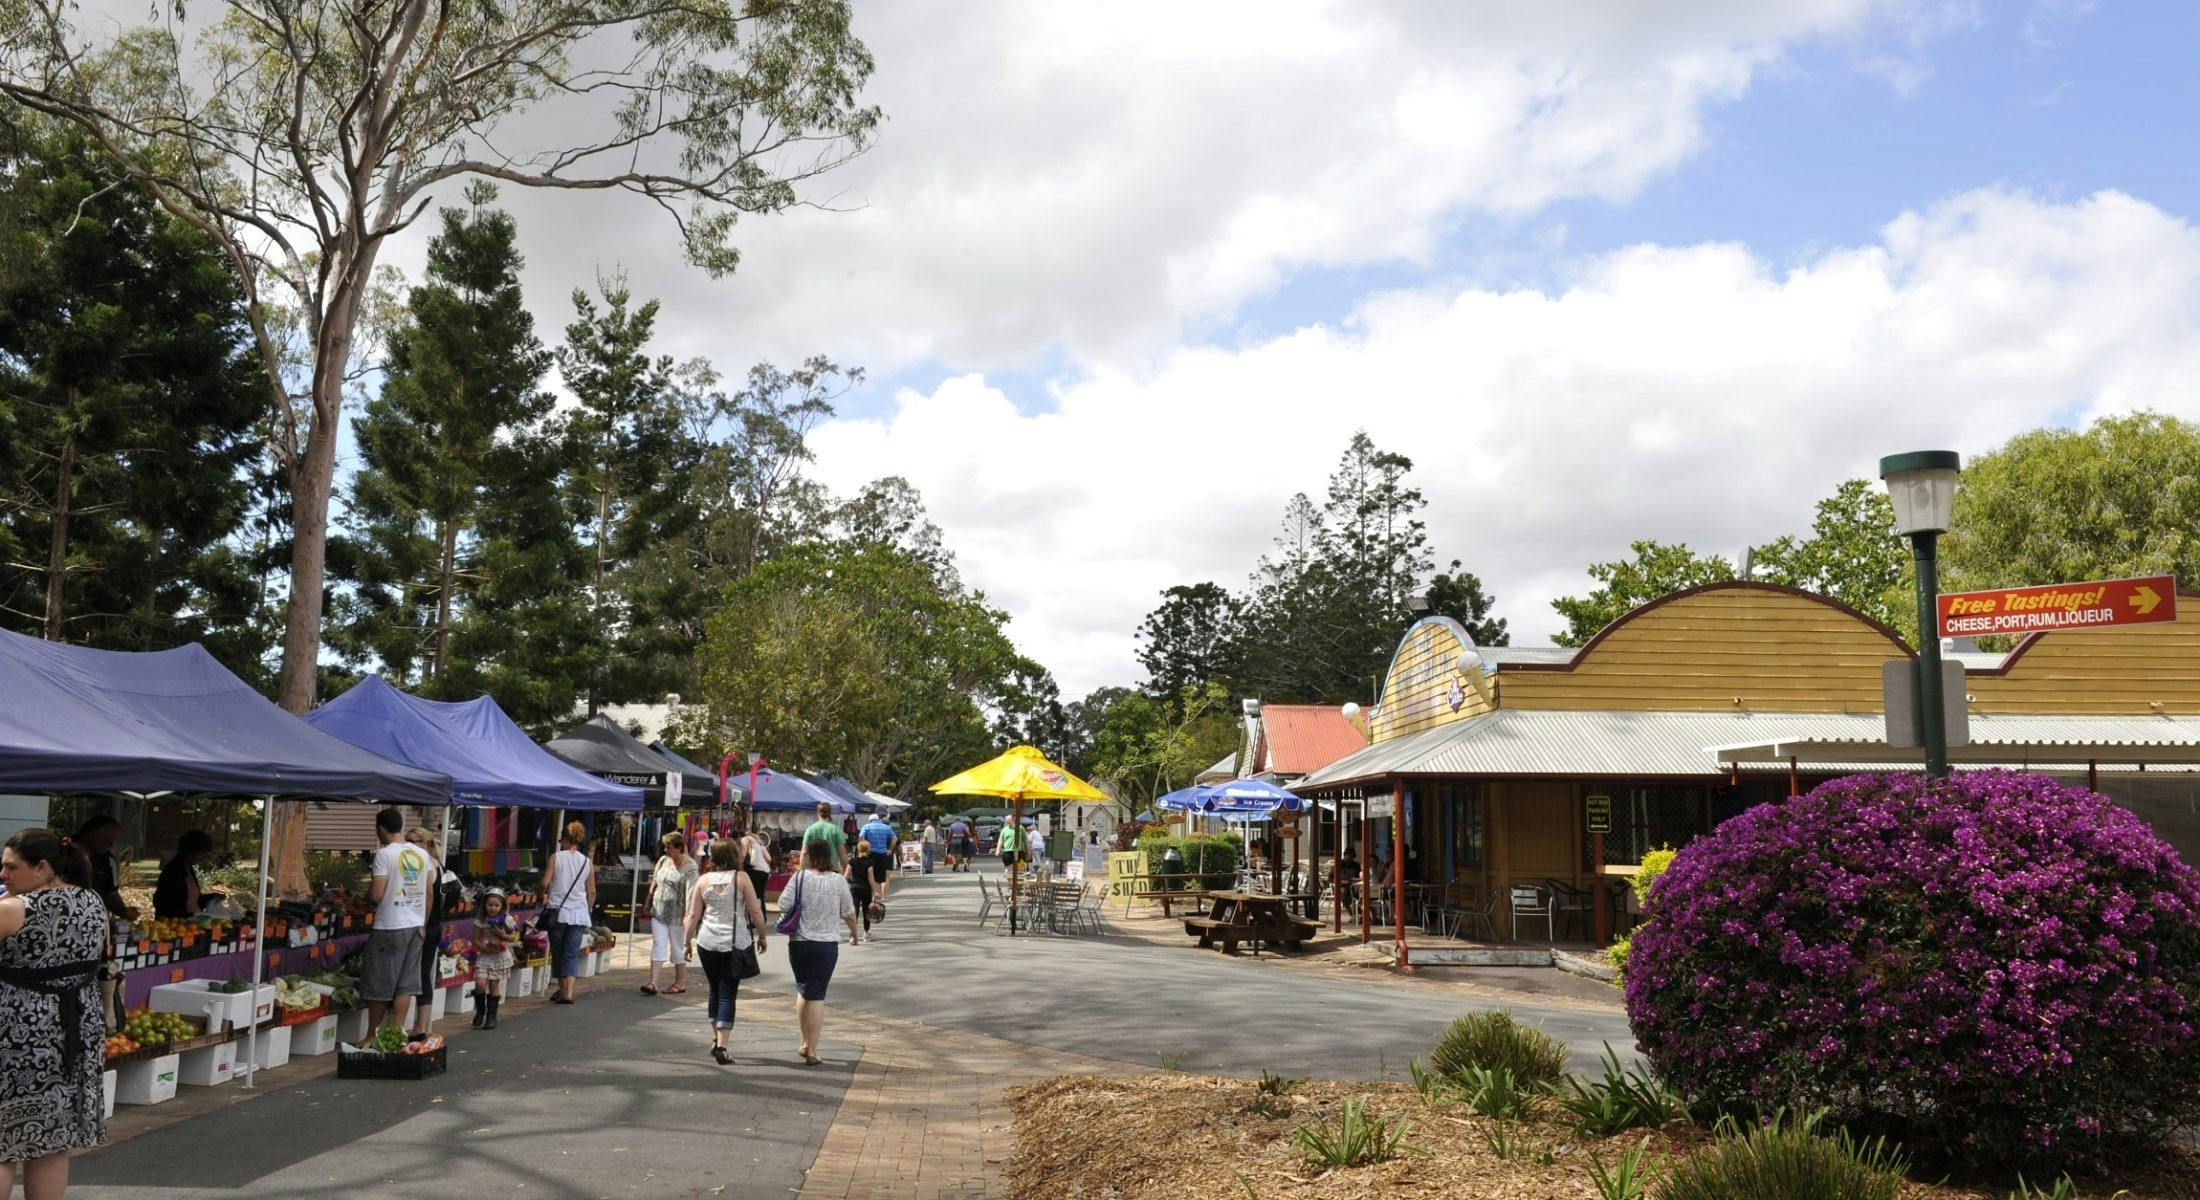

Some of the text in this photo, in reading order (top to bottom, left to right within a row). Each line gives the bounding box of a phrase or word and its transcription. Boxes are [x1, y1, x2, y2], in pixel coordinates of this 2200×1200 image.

[1948, 586, 2106, 615] Free Tastings!
[604, 773, 649, 785] Wanderer
